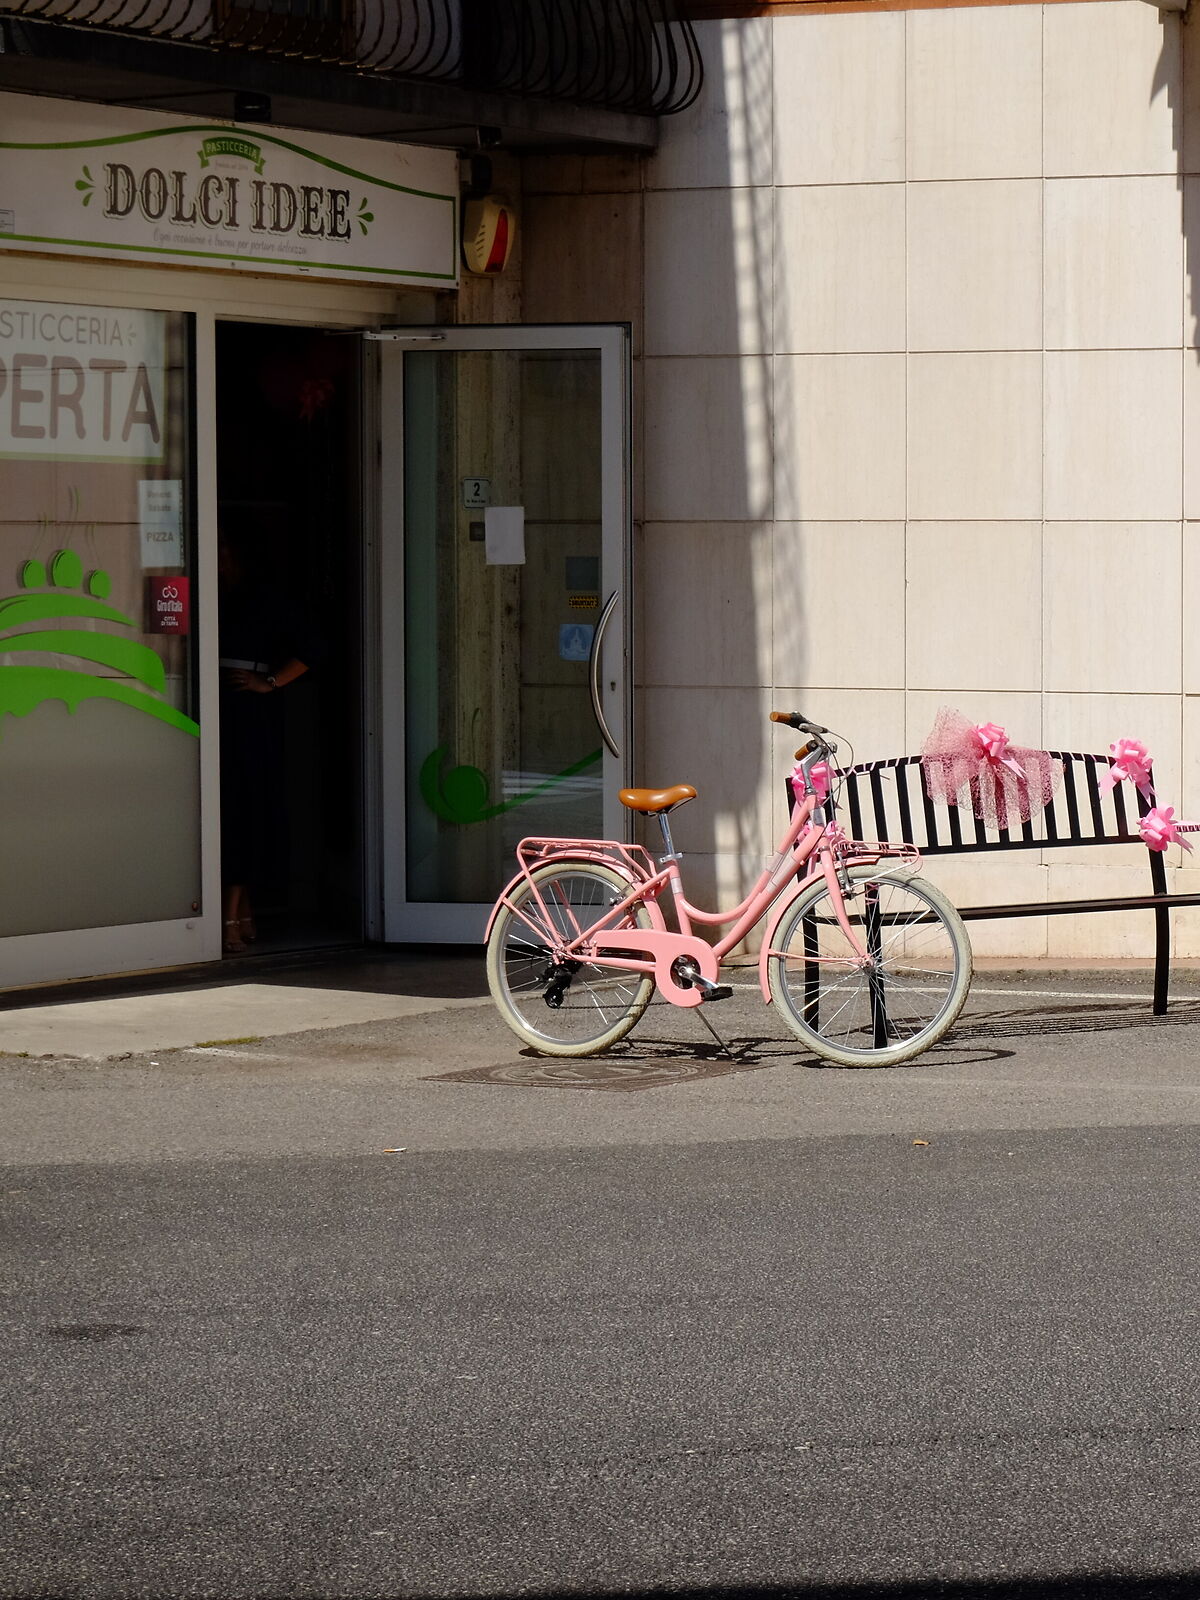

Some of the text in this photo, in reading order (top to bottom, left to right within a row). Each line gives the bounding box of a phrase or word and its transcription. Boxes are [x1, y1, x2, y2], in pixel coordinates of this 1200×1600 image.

[206, 141, 257, 159] PASTICCERIA
[104, 163, 351, 243] DOLCI IDEE
[0, 353, 160, 444] ERTA
[473, 482, 481, 496] 2
[146, 532, 174, 542] PIZZA
